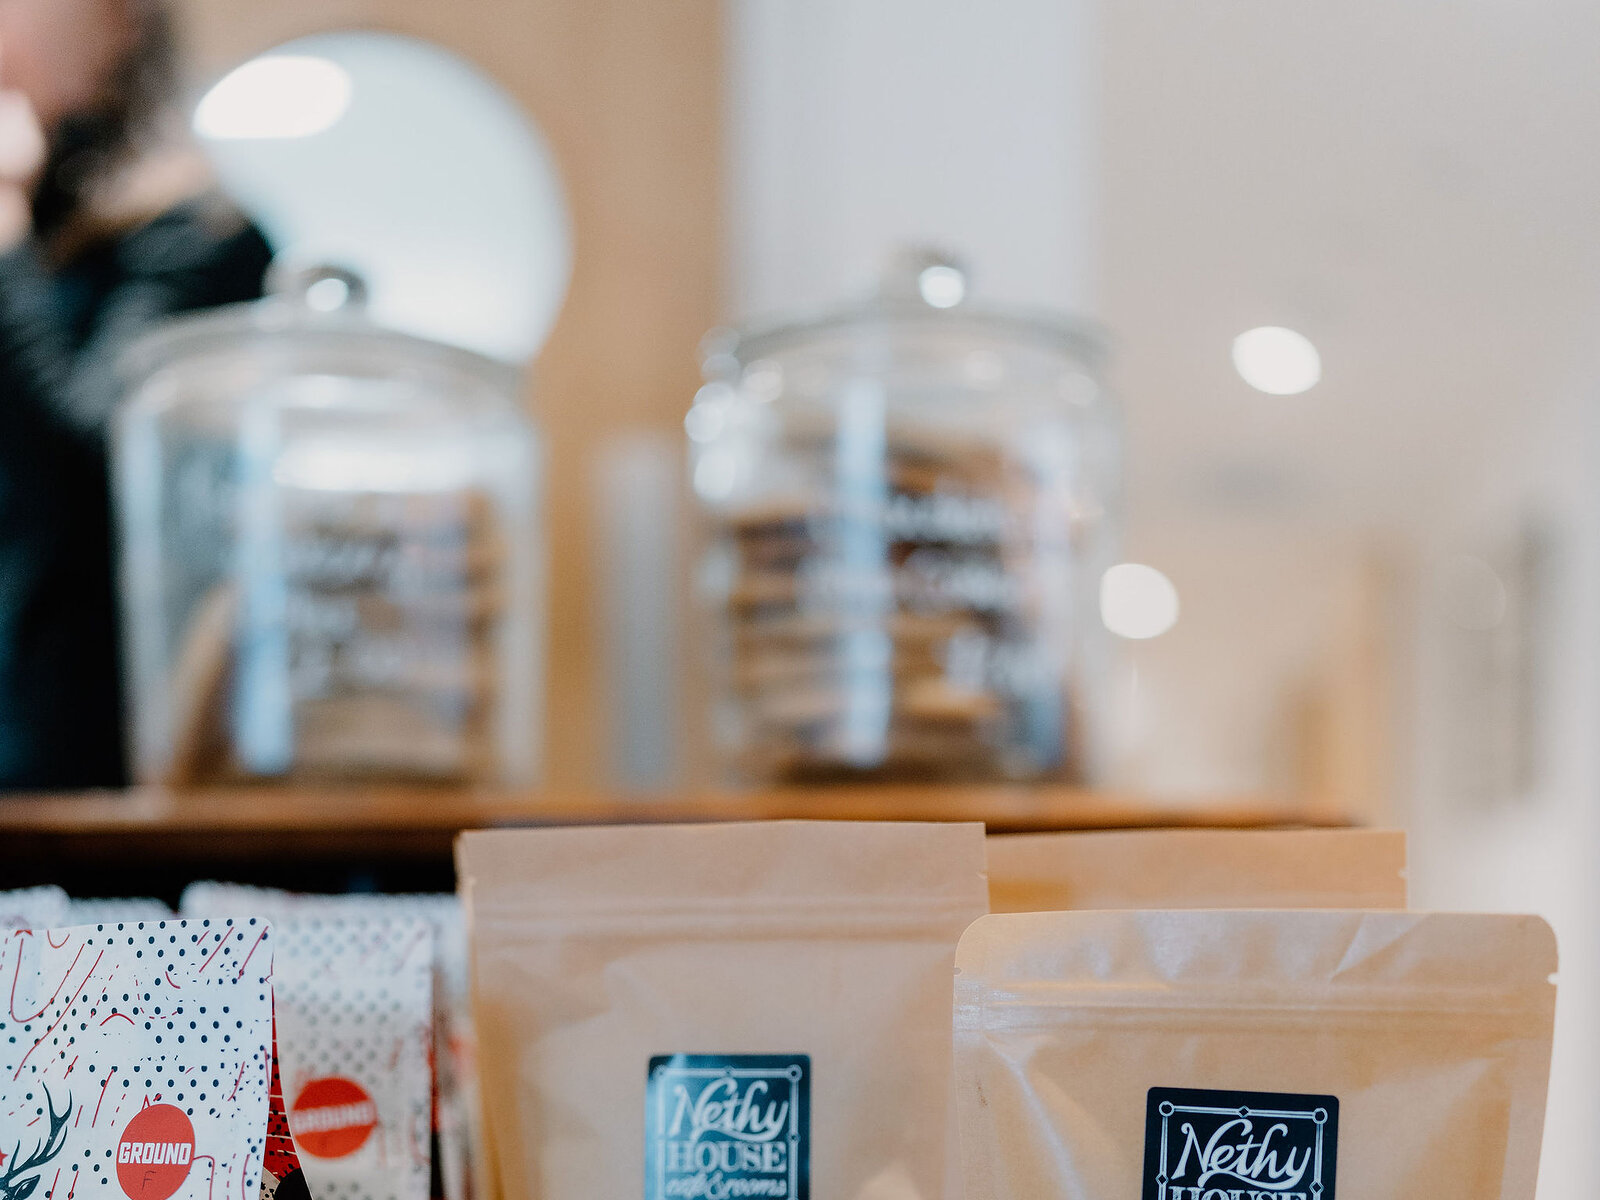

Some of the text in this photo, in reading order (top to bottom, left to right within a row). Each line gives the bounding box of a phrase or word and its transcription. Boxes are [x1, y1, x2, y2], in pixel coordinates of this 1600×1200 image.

[669, 1077, 788, 1142] Nethy
[118, 1142, 192, 1165] GROUND
[666, 1140, 788, 1174] HOUSE
[1171, 1118, 1312, 1190] Nethy
